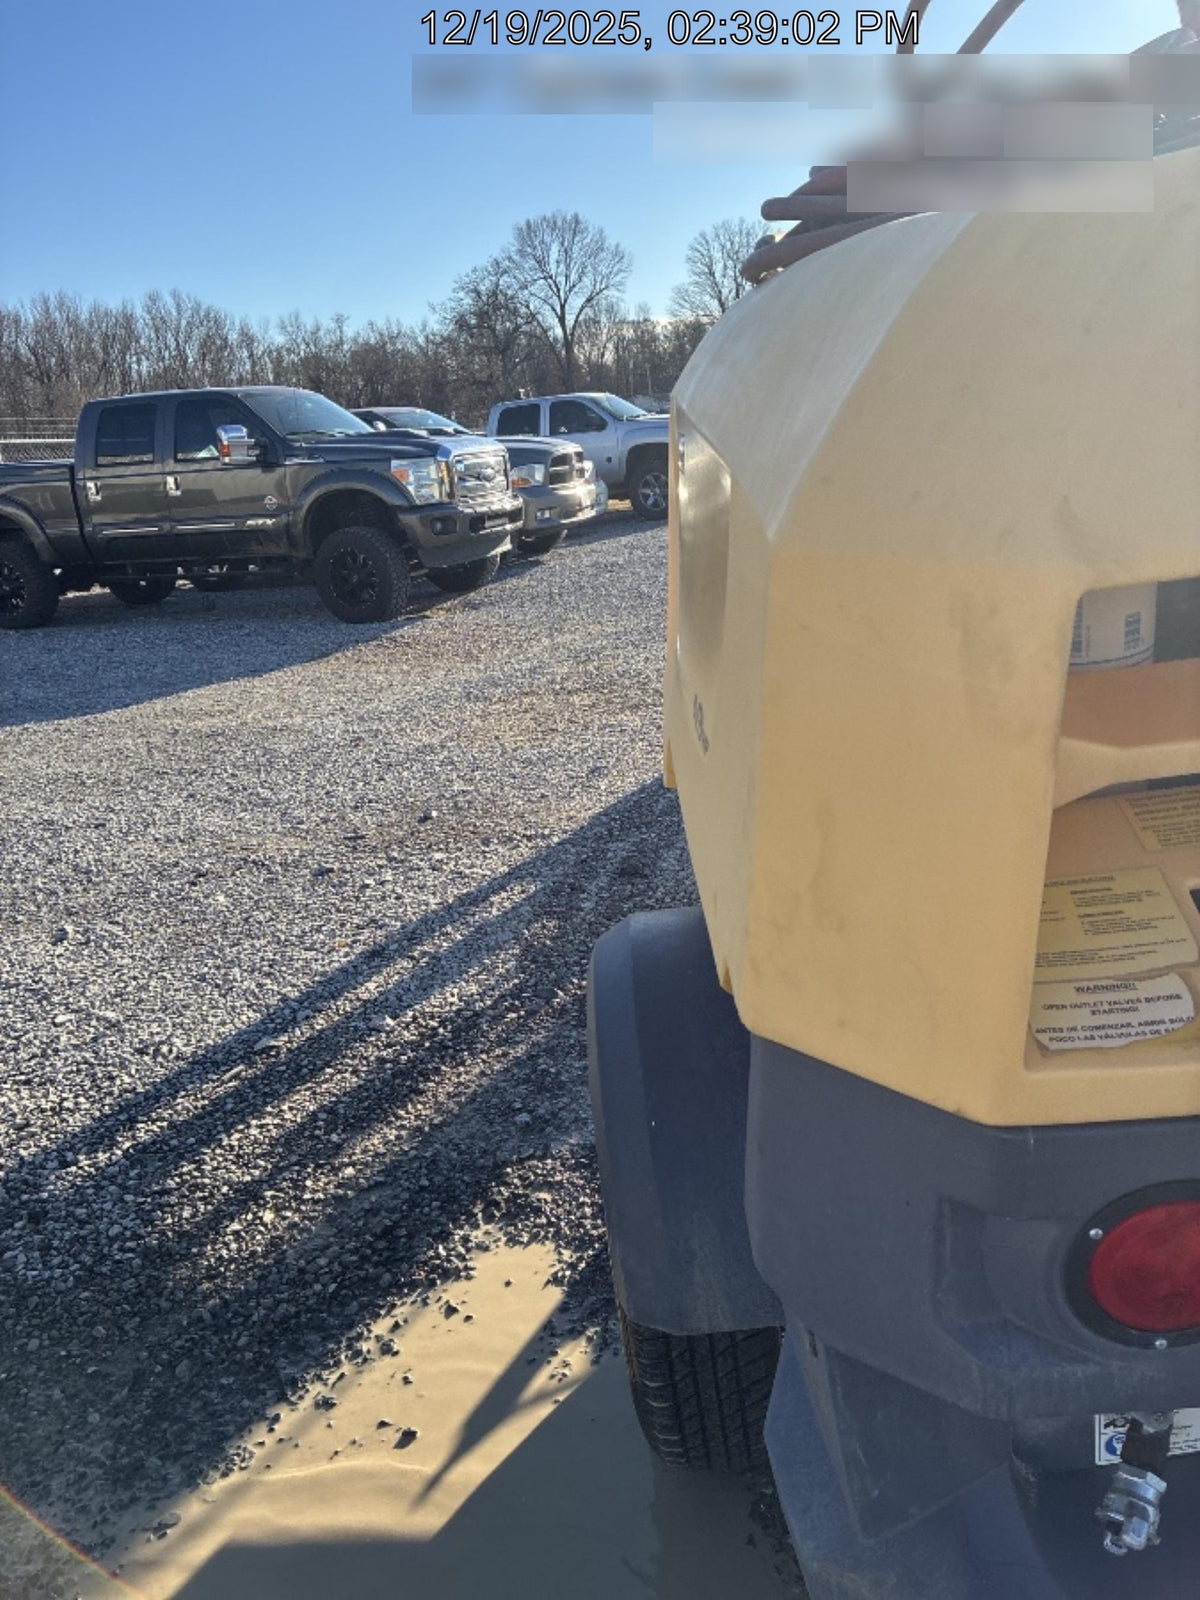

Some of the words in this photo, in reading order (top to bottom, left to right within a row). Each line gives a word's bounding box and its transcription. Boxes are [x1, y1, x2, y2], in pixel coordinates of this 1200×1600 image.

[1042, 1002, 1068, 1011] OPEN
[1069, 1000, 1103, 1010] OUTLET
[1105, 997, 1142, 1007] VALVES
[1143, 993, 1183, 1003] BEFORE
[1034, 1025, 1064, 1034] ANTES
[1065, 1024, 1079, 1034] DE
[1048, 1034, 1075, 1043] POCO
[1076, 1033, 1097, 1042] LAS
